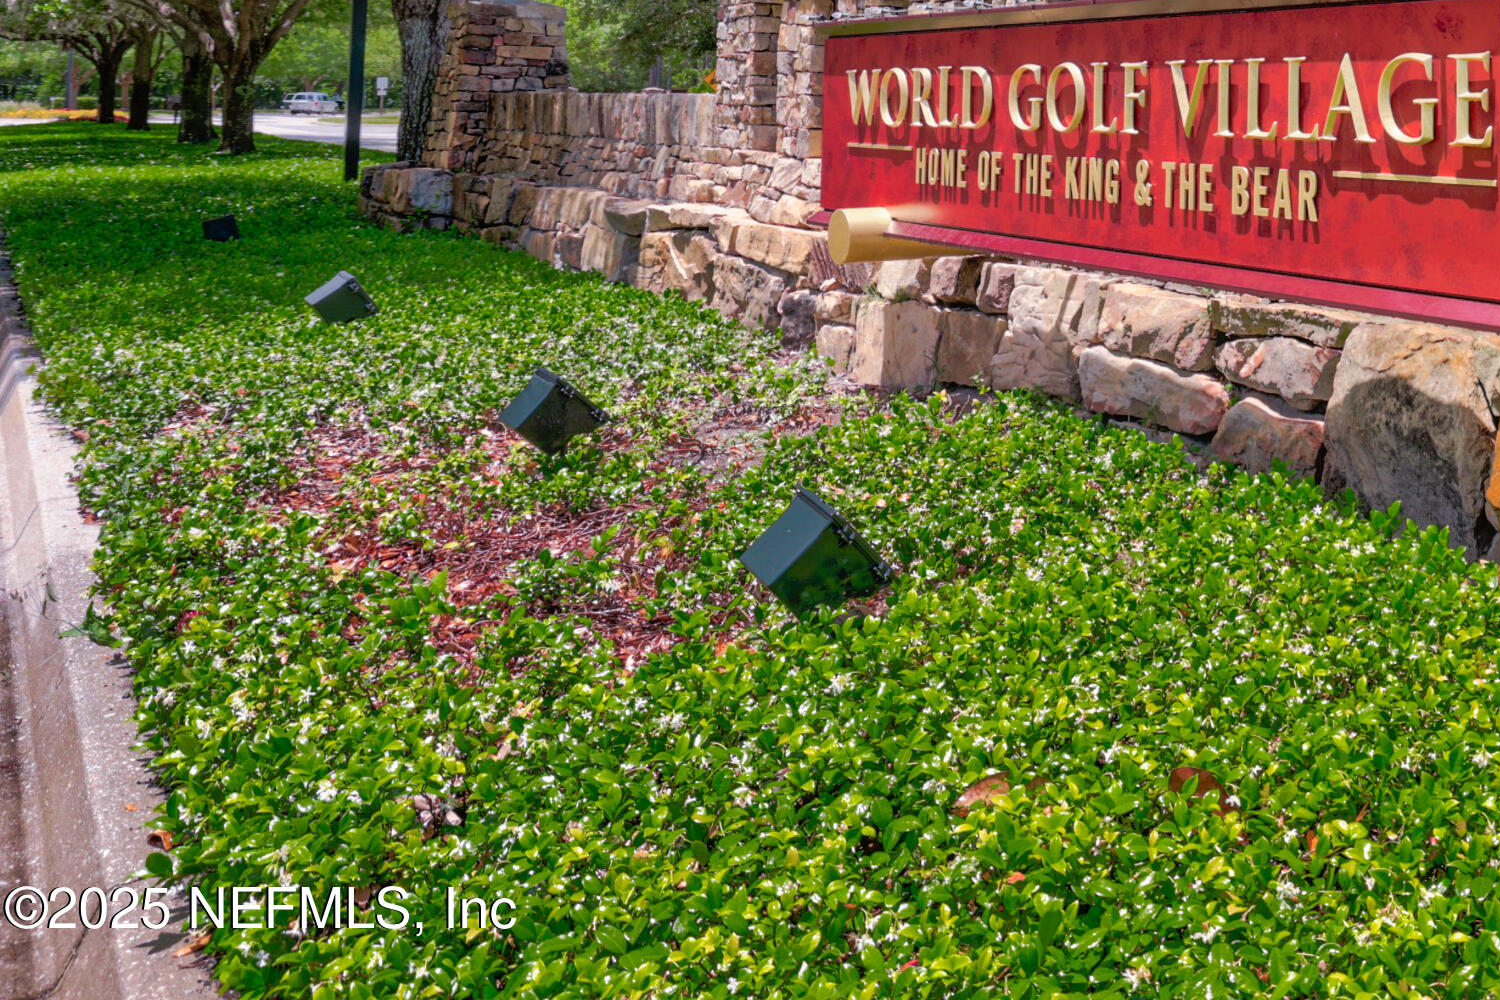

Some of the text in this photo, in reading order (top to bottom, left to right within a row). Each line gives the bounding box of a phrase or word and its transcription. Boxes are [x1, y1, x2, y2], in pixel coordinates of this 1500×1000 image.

[846, 50, 1493, 148] WORLD GOLF VILLAGE
[915, 147, 1318, 222] HOME OF THE KING & THE BEAR
